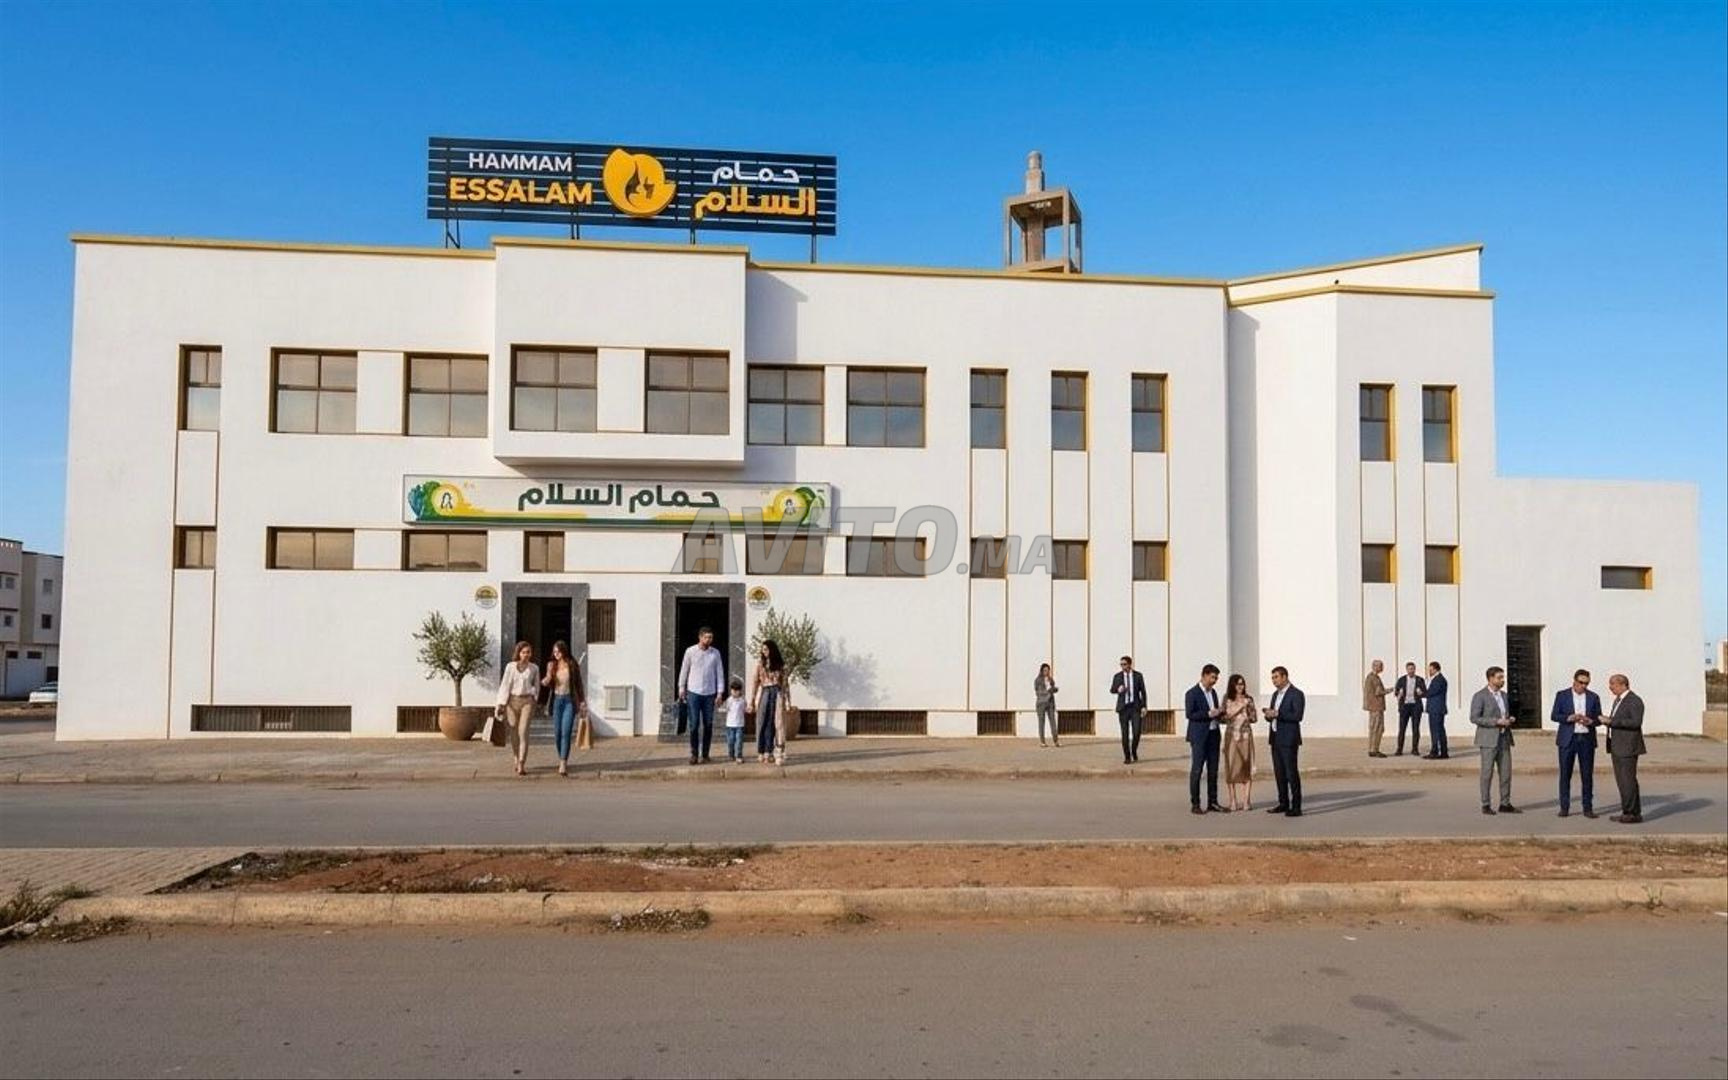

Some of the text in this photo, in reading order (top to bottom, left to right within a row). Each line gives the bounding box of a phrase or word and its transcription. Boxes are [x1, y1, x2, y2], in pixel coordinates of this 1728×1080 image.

[468, 152, 573, 173] HAMMAM
[711, 161, 800, 185] حمام
[449, 177, 593, 205] ESSALAM
[694, 185, 817, 219] السلام
[518, 483, 721, 513] حمام السلام
